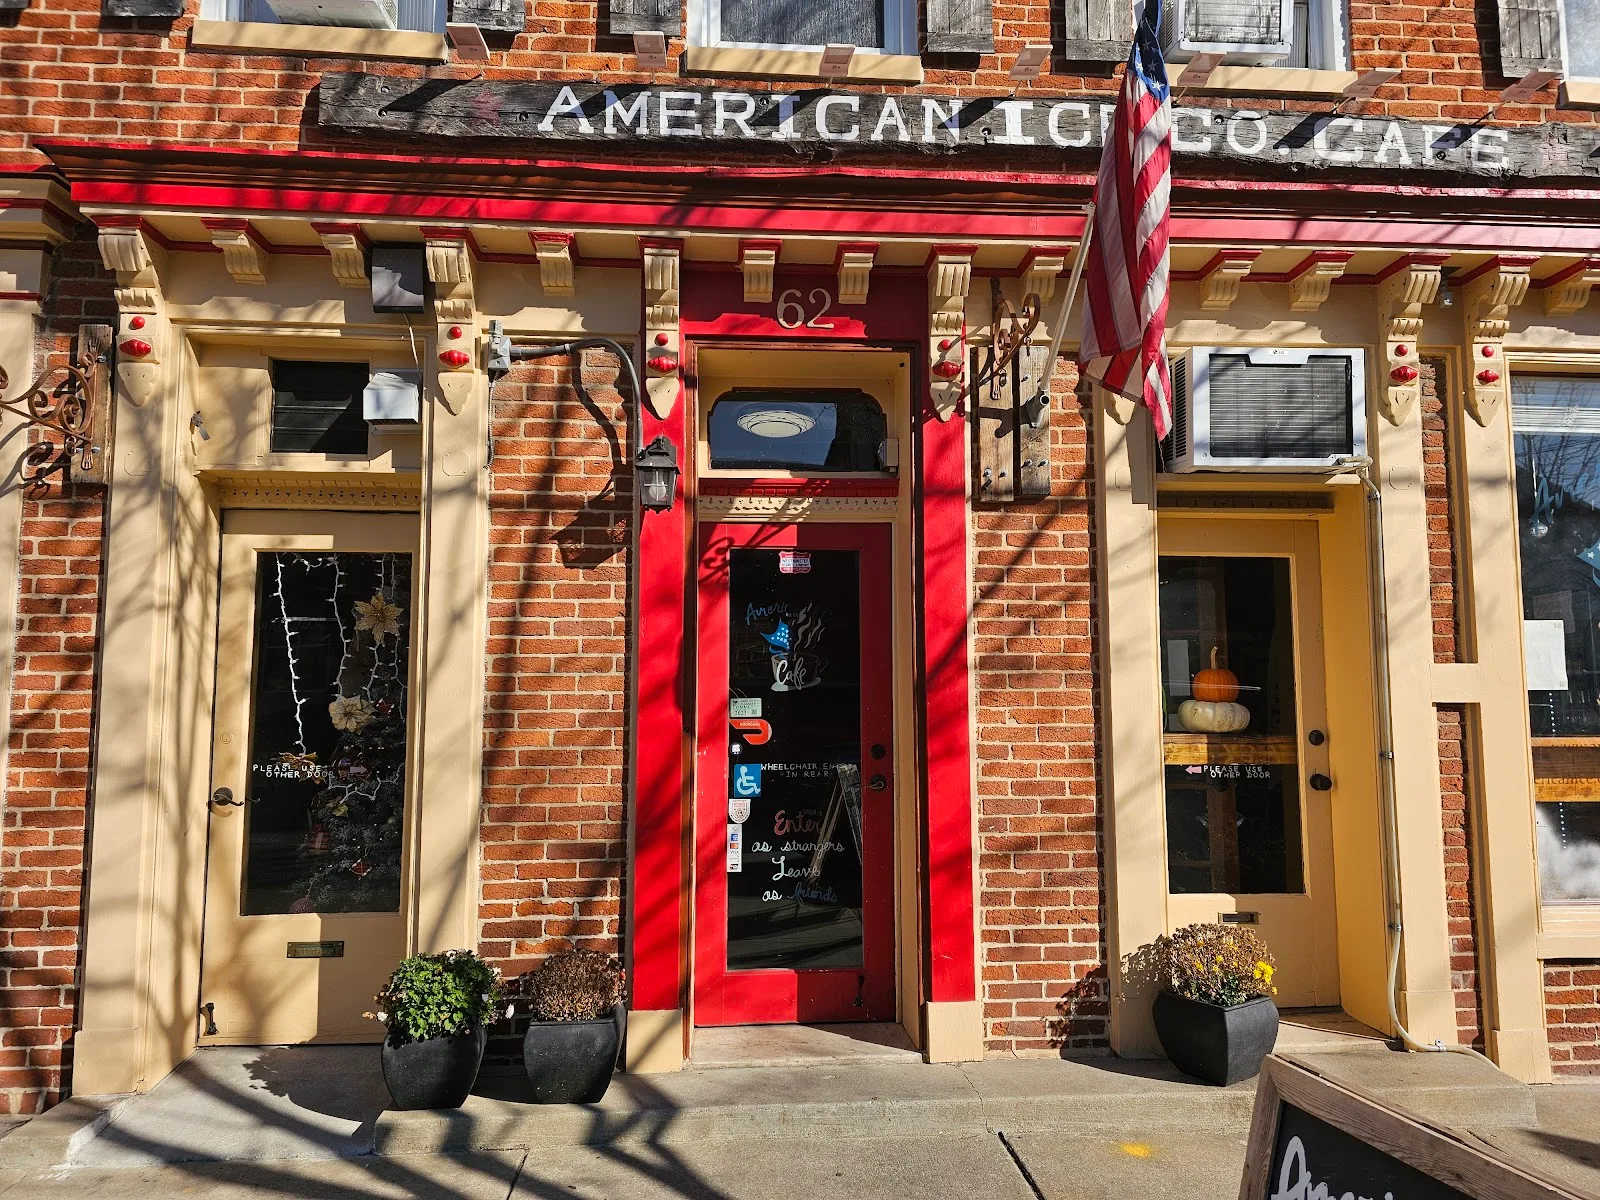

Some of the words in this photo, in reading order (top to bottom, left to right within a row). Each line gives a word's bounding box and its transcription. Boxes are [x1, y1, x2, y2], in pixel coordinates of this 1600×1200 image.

[537, 85, 963, 144] AMERICAN
[1313, 116, 1511, 169] CAFE
[776, 288, 834, 330] 62
[776, 657, 807, 691] Cafe
[760, 763, 818, 771] WHEELCHAIR
[773, 809, 821, 836] Enter
[751, 841, 773, 853] as
[780, 840, 845, 860] strangers
[772, 855, 821, 881] Leave
[762, 889, 782, 902] as
[787, 882, 838, 906] friends
